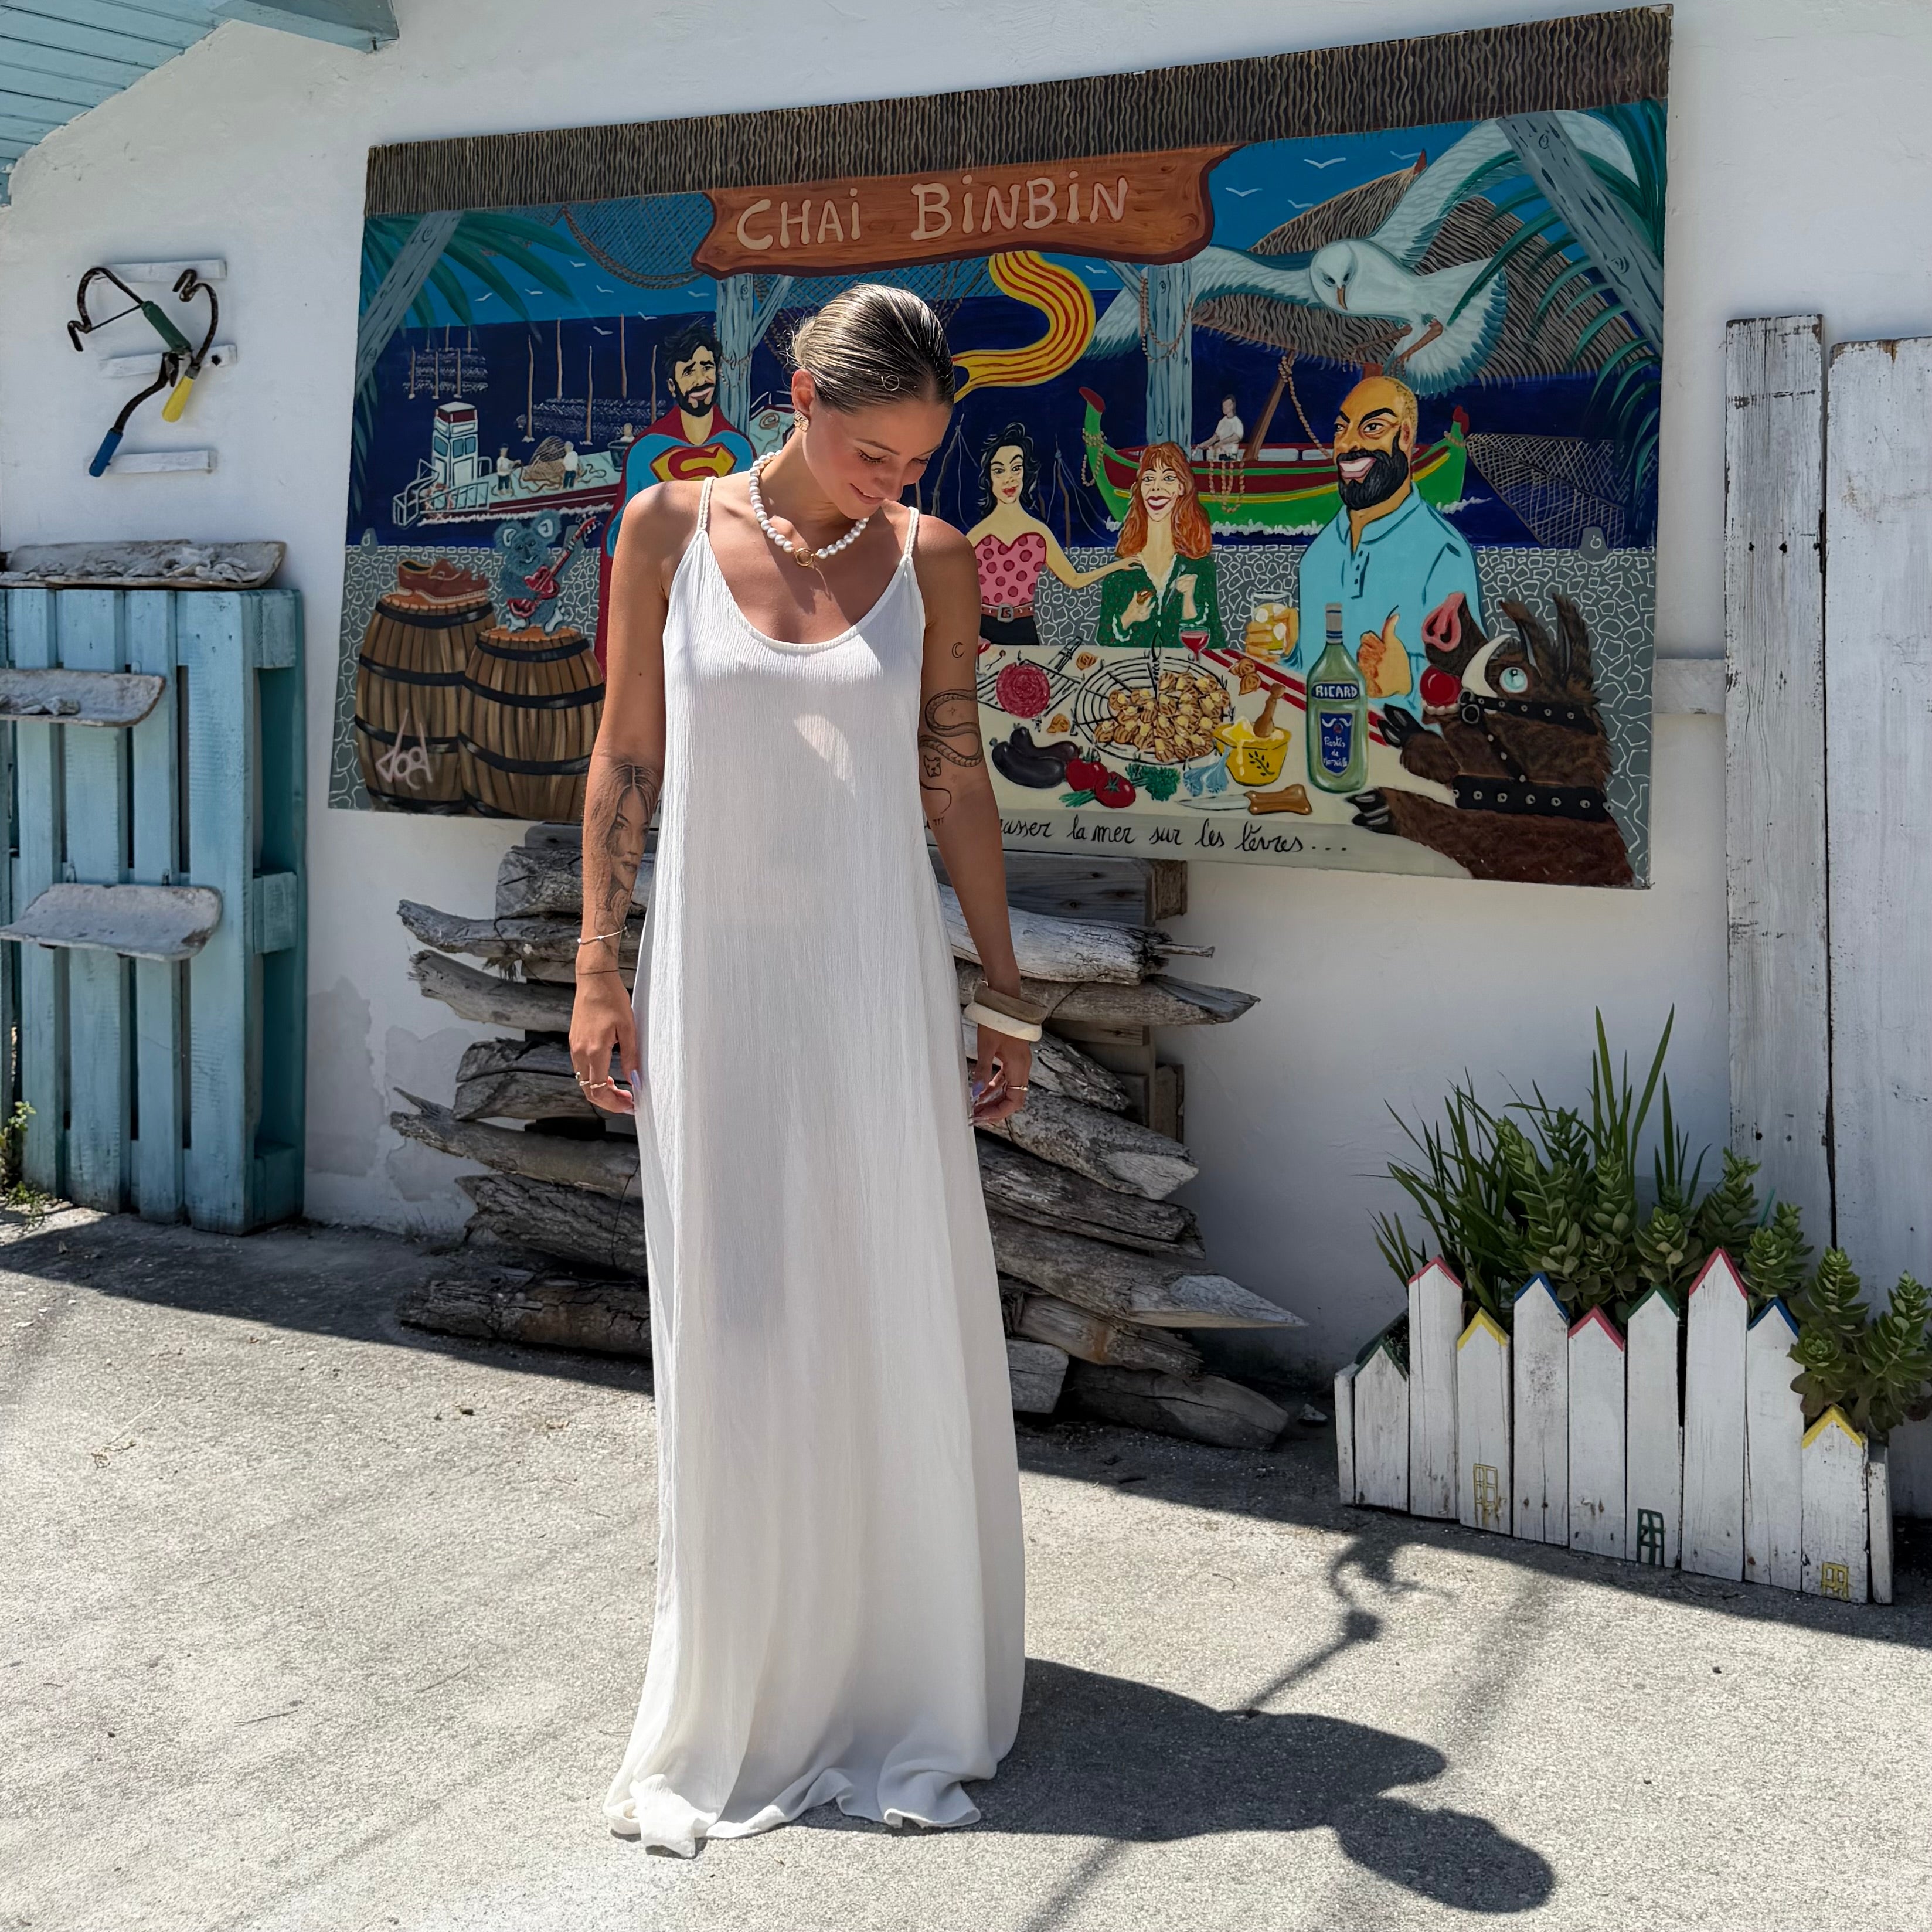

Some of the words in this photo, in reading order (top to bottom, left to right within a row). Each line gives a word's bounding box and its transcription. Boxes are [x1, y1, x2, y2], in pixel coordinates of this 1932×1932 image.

[1315, 685, 1358, 698] RICARD
[1000, 819, 1053, 838] asser
[1066, 814, 1087, 840] la
[1090, 824, 1136, 845] mer
[1149, 826, 1183, 846] sur
[1194, 818, 1225, 848] les
